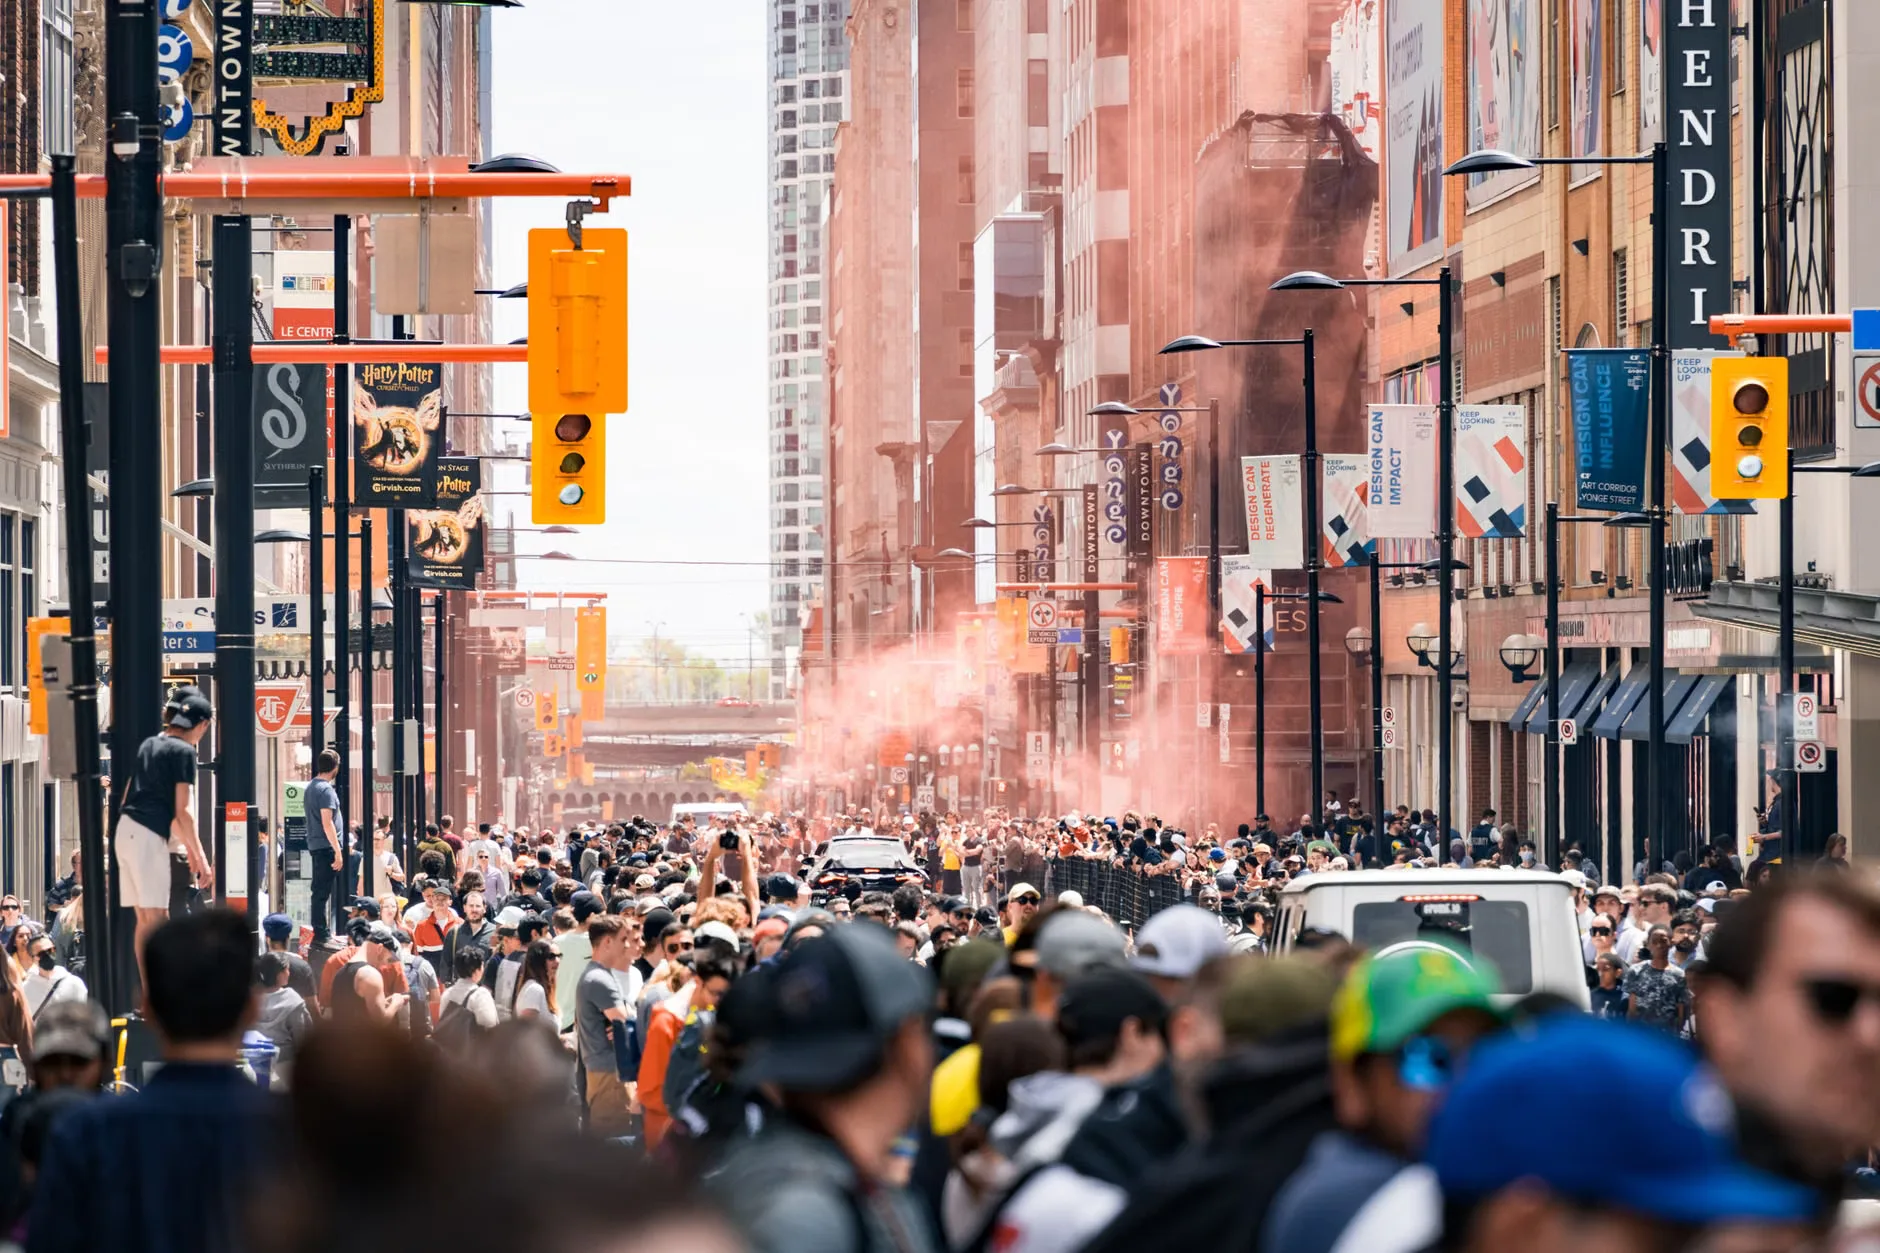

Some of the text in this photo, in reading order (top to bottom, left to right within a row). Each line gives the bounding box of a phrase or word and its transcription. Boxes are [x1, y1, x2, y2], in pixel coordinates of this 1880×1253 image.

[281, 327, 333, 337] LE CENTR
[362, 362, 434, 387] Harry Potter
[1677, 358, 1701, 366] KEEP
[1678, 374, 1691, 382] UP
[1573, 355, 1593, 467] DESIGN CAN
[1596, 363, 1614, 469] INFLUENCE
[448, 463, 470, 472] STAGE
[1371, 411, 1384, 505] DESIGN CAN
[443, 475, 472, 493] Potter
[1390, 448, 1401, 505] IMPACT
[1581, 481, 1638, 494] ART CORRIDOR
[1140, 451, 1149, 541] DOWNTOWN
[1246, 465, 1260, 541] DESIGN CAN
[1261, 460, 1275, 541] REGENERATE
[1581, 493, 1637, 505] YONGE STREET
[1087, 491, 1096, 573] DOWNTOWN
[1159, 561, 1170, 632] DESIGN CAN
[1174, 587, 1184, 631] INSPIRE
[163, 637, 198, 649] ter St
[919, 794, 932, 803] 40
